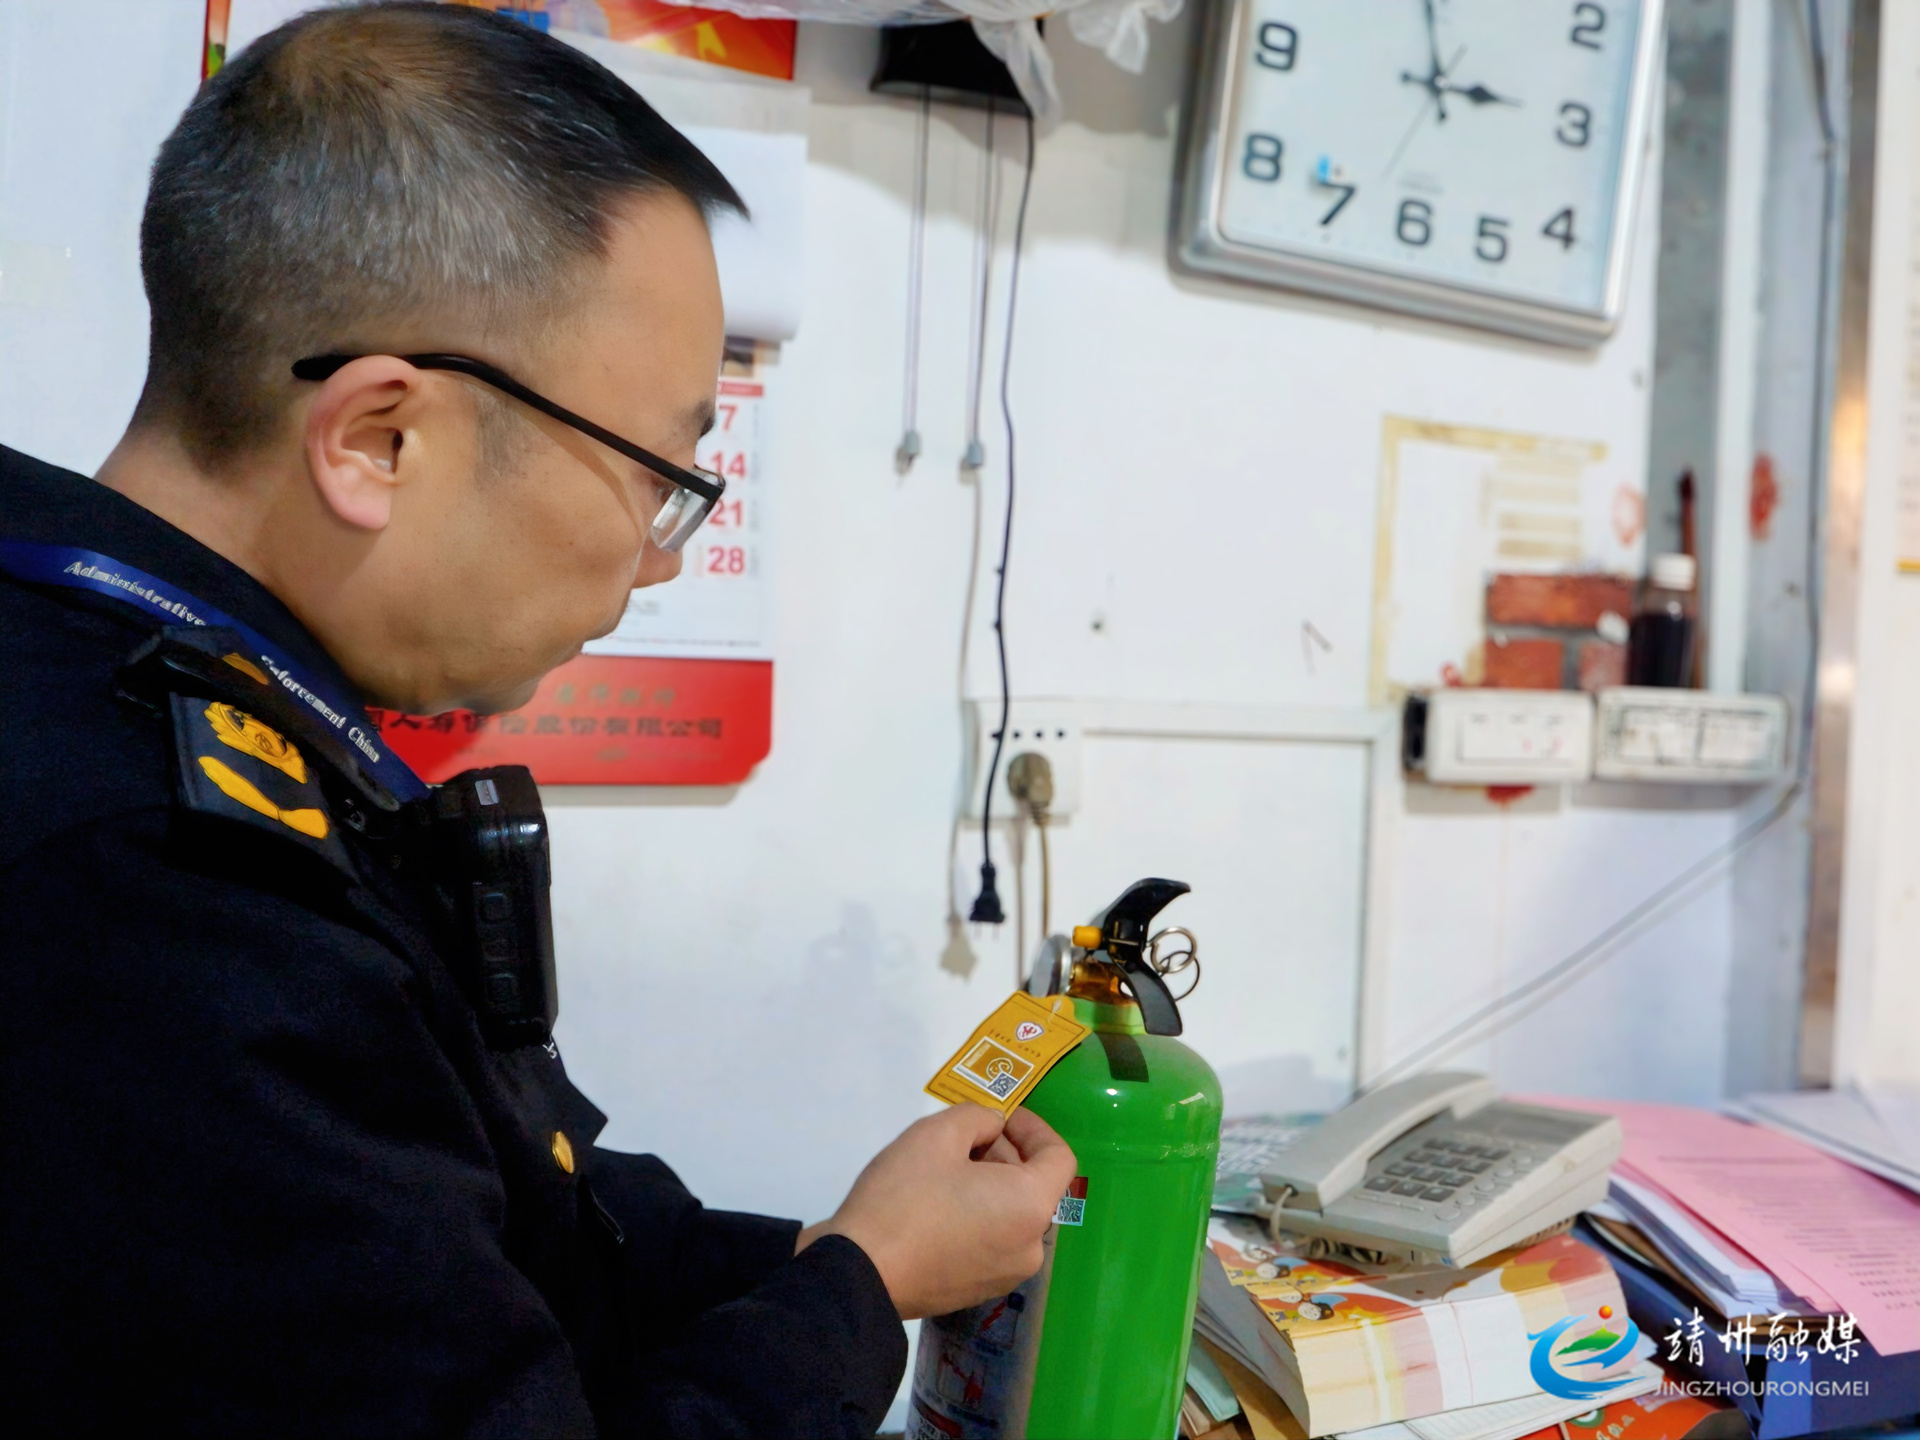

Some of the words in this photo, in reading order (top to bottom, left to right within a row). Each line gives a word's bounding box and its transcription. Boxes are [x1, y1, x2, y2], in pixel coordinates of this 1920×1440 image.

[1255, 22, 1297, 72] 9
[1571, 3, 1606, 50] 2
[1557, 103, 1591, 147] 3
[1243, 132, 1282, 182] 8
[1318, 181, 1356, 226] 7
[1397, 199, 1432, 246] 6
[1475, 216, 1509, 263] 5
[1542, 208, 1576, 250] 4
[719, 404, 738, 432] 7
[709, 452, 746, 478] 14
[709, 500, 743, 527] 21
[708, 546, 745, 574] 28
[64, 561, 207, 627] Administrative
[348, 727, 380, 763] China
